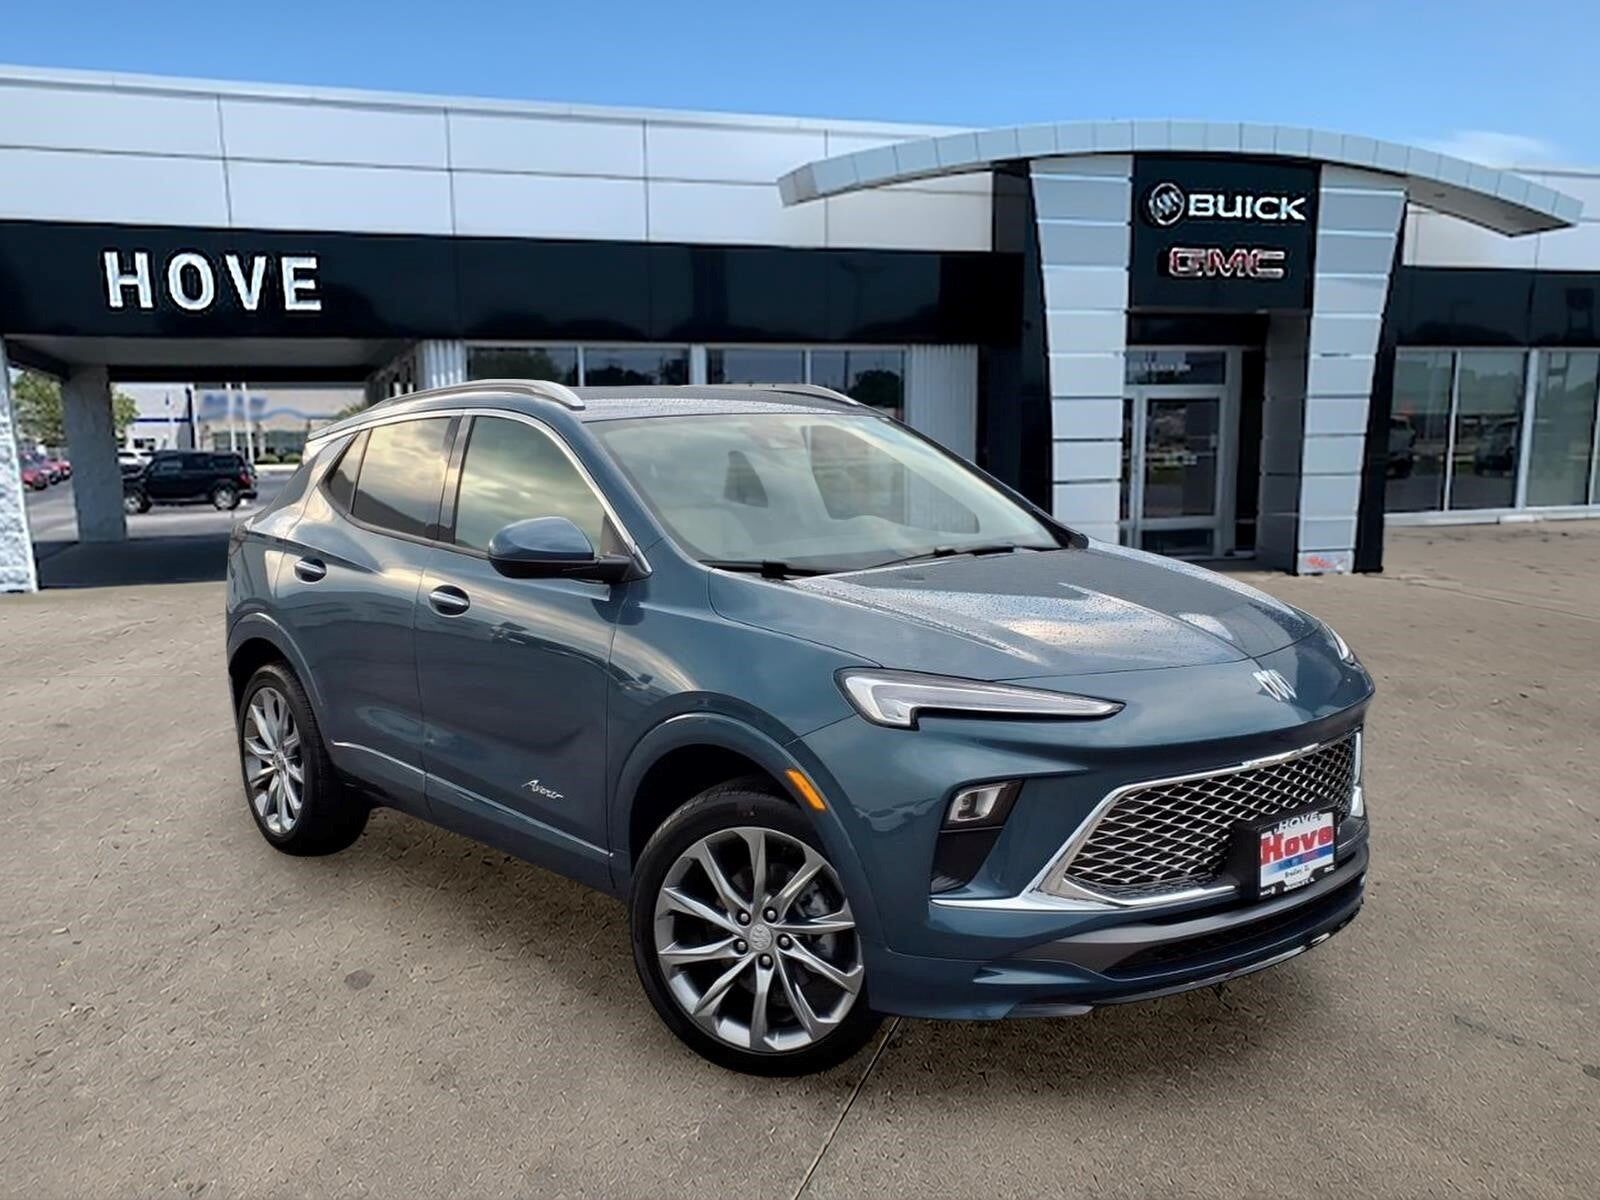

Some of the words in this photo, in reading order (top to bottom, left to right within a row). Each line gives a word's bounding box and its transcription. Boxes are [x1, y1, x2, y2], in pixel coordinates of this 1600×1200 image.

[1188, 193, 1306, 221] BUICK
[1168, 246, 1286, 278] GMC
[104, 251, 322, 311] HOVE
